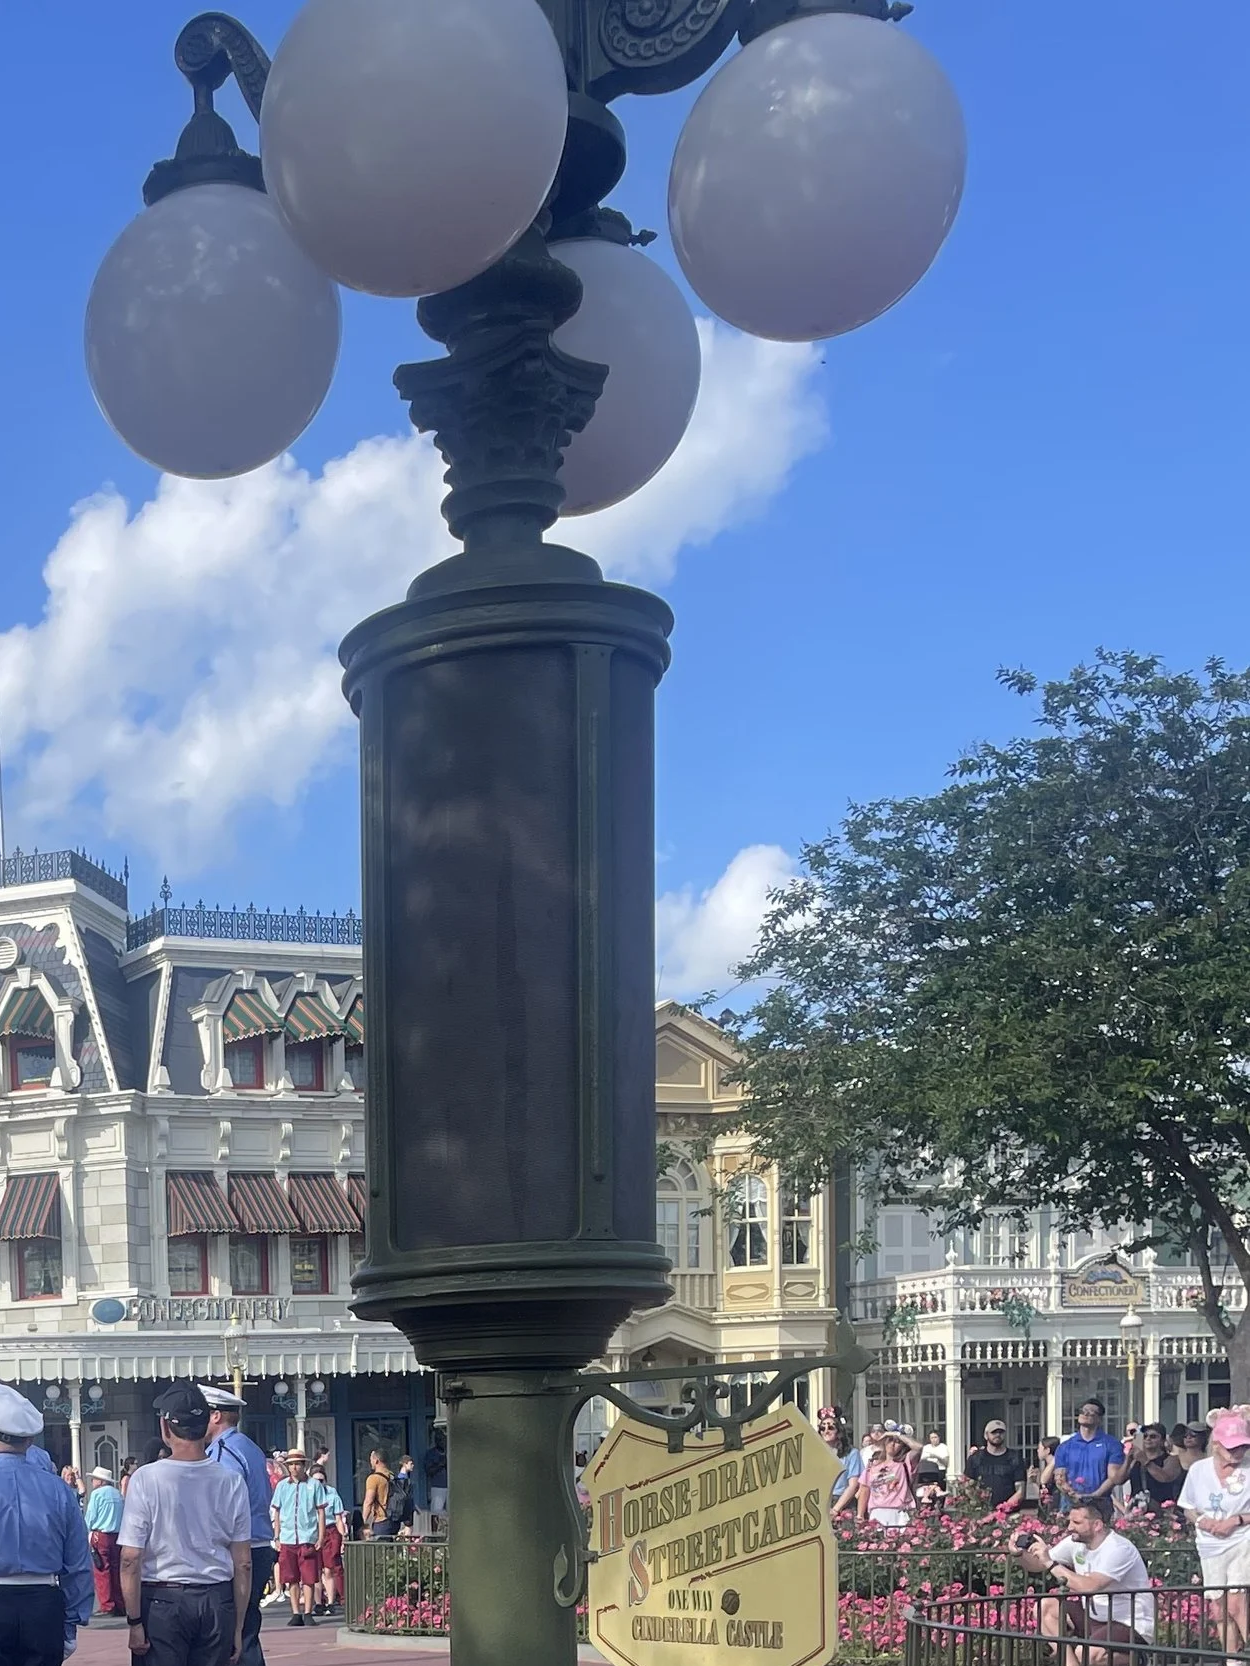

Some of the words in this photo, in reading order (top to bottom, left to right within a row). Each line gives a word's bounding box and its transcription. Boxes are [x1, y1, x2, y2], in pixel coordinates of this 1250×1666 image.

[1069, 1283, 1139, 1297] CONFECTIONERY
[126, 1297, 291, 1322] CONFECTIONERY
[598, 1433, 805, 1557] HORSE-DRAWN
[628, 1489, 822, 1607] STREETCARS
[668, 1589, 689, 1610] ONE
[692, 1590, 714, 1612] WAY
[632, 1615, 719, 1645] CINDERELLA
[726, 1619, 783, 1649] CASTLE
